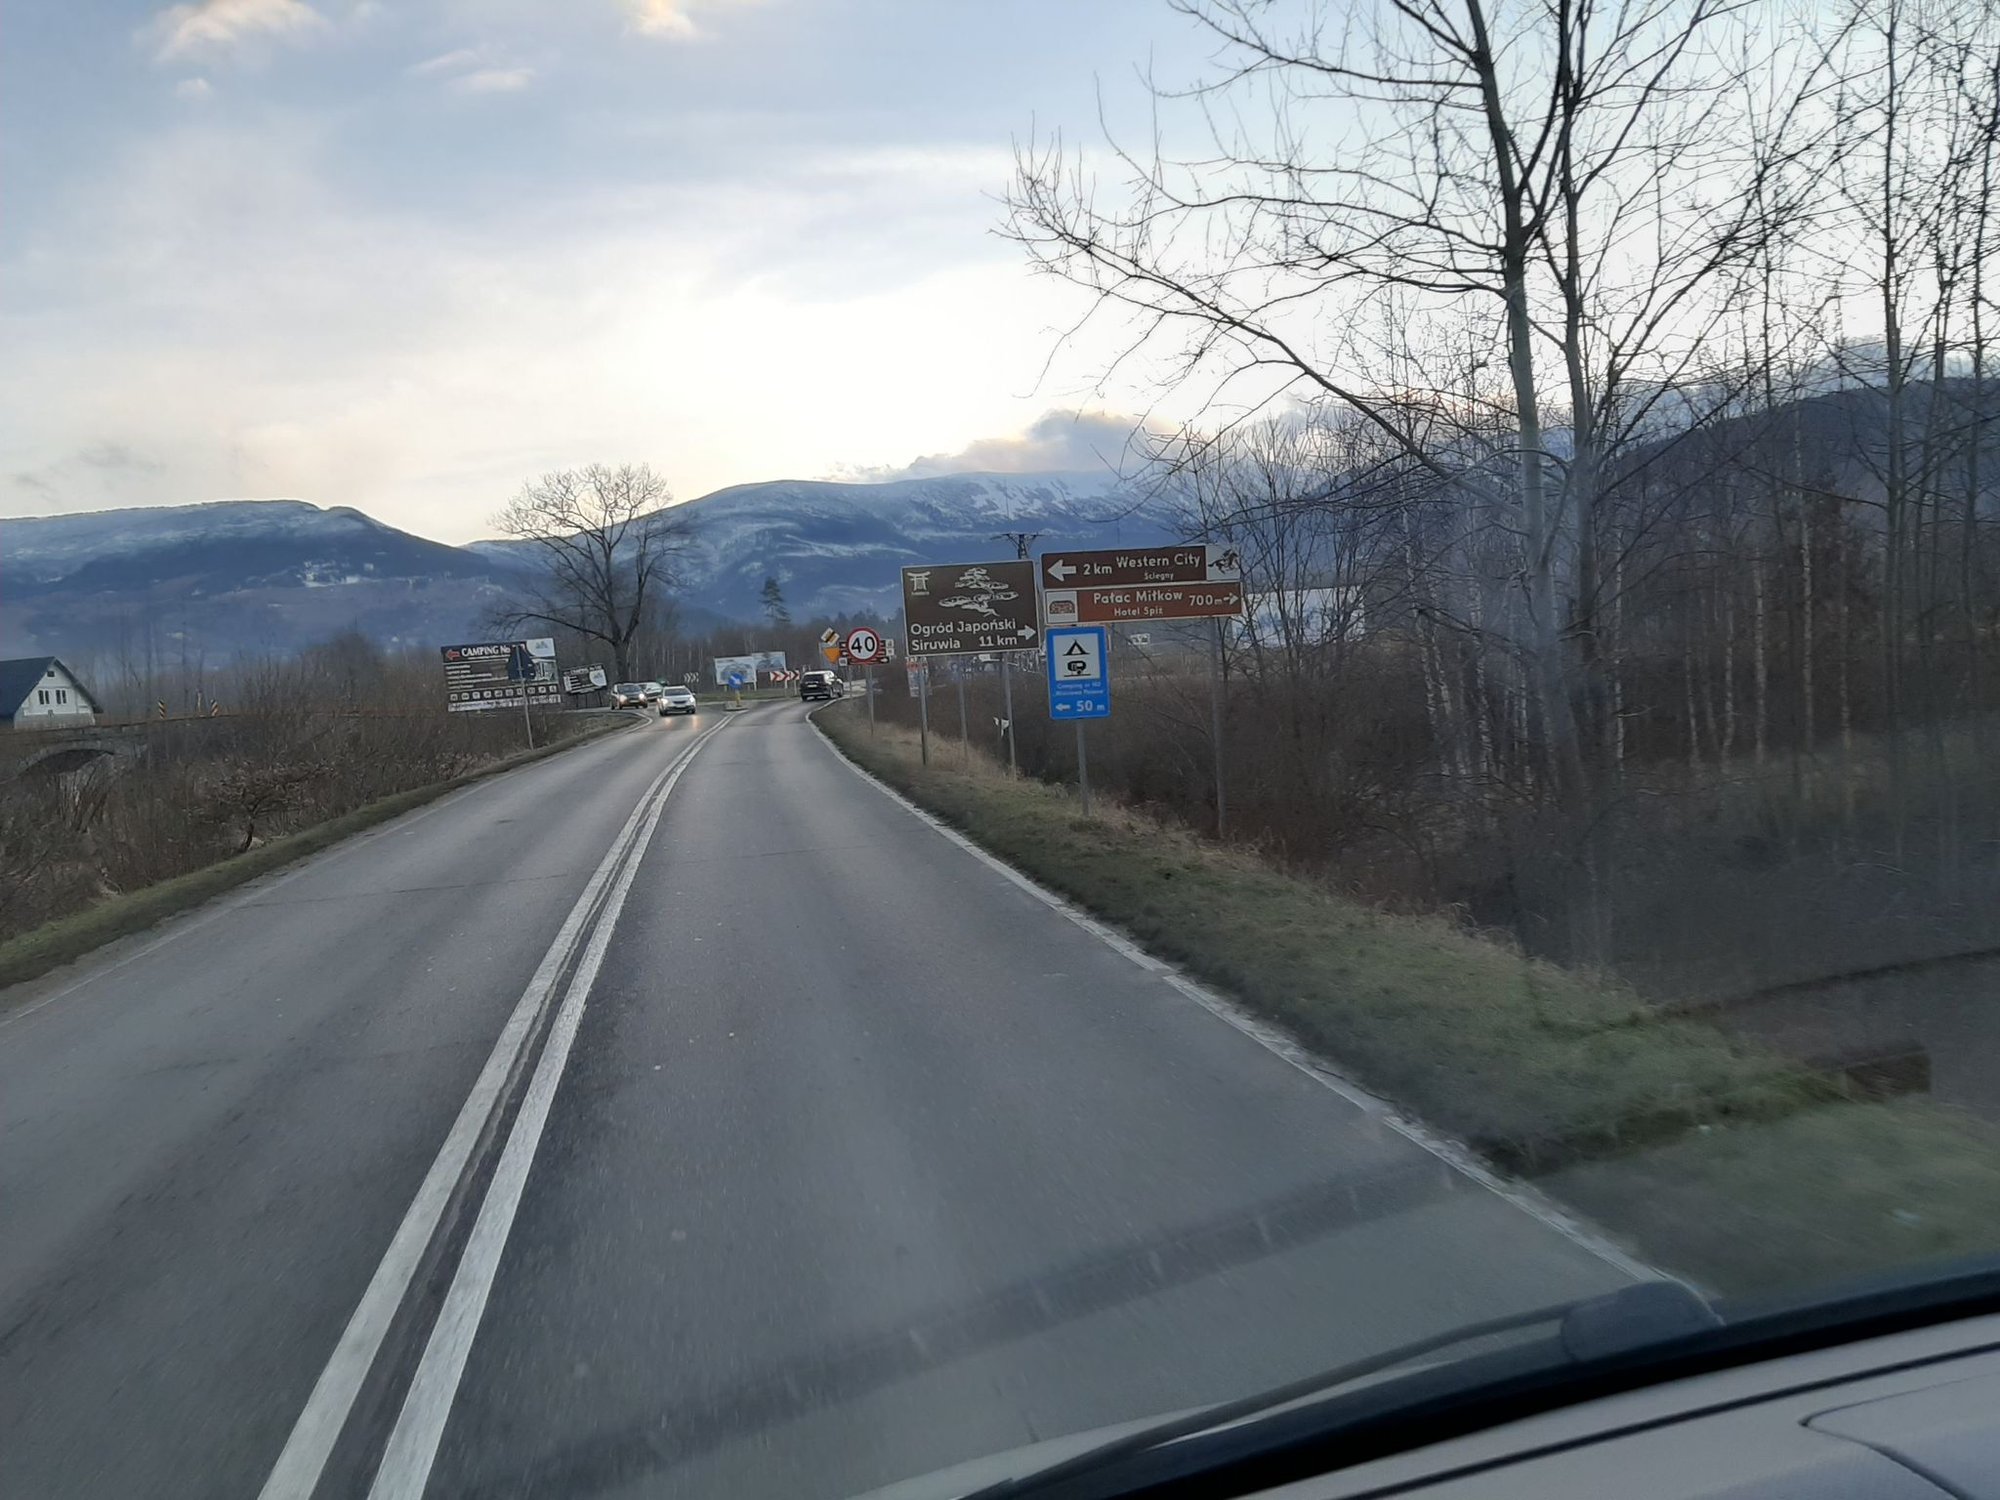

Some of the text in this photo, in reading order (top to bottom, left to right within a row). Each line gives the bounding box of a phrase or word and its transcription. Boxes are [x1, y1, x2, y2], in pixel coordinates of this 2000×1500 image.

[1083, 553, 1200, 575] 2 km Western City
[1094, 592, 1130, 605] Pałac
[1136, 589, 1182, 603] Miłków
[1114, 607, 1140, 617] Hotel
[911, 618, 1016, 637] Ogród Japoński
[851, 636, 875, 653] 40
[979, 636, 994, 647] 11
[997, 635, 1017, 646] km
[461, 646, 499, 657] CAMPING
[1076, 700, 1093, 711] 50
